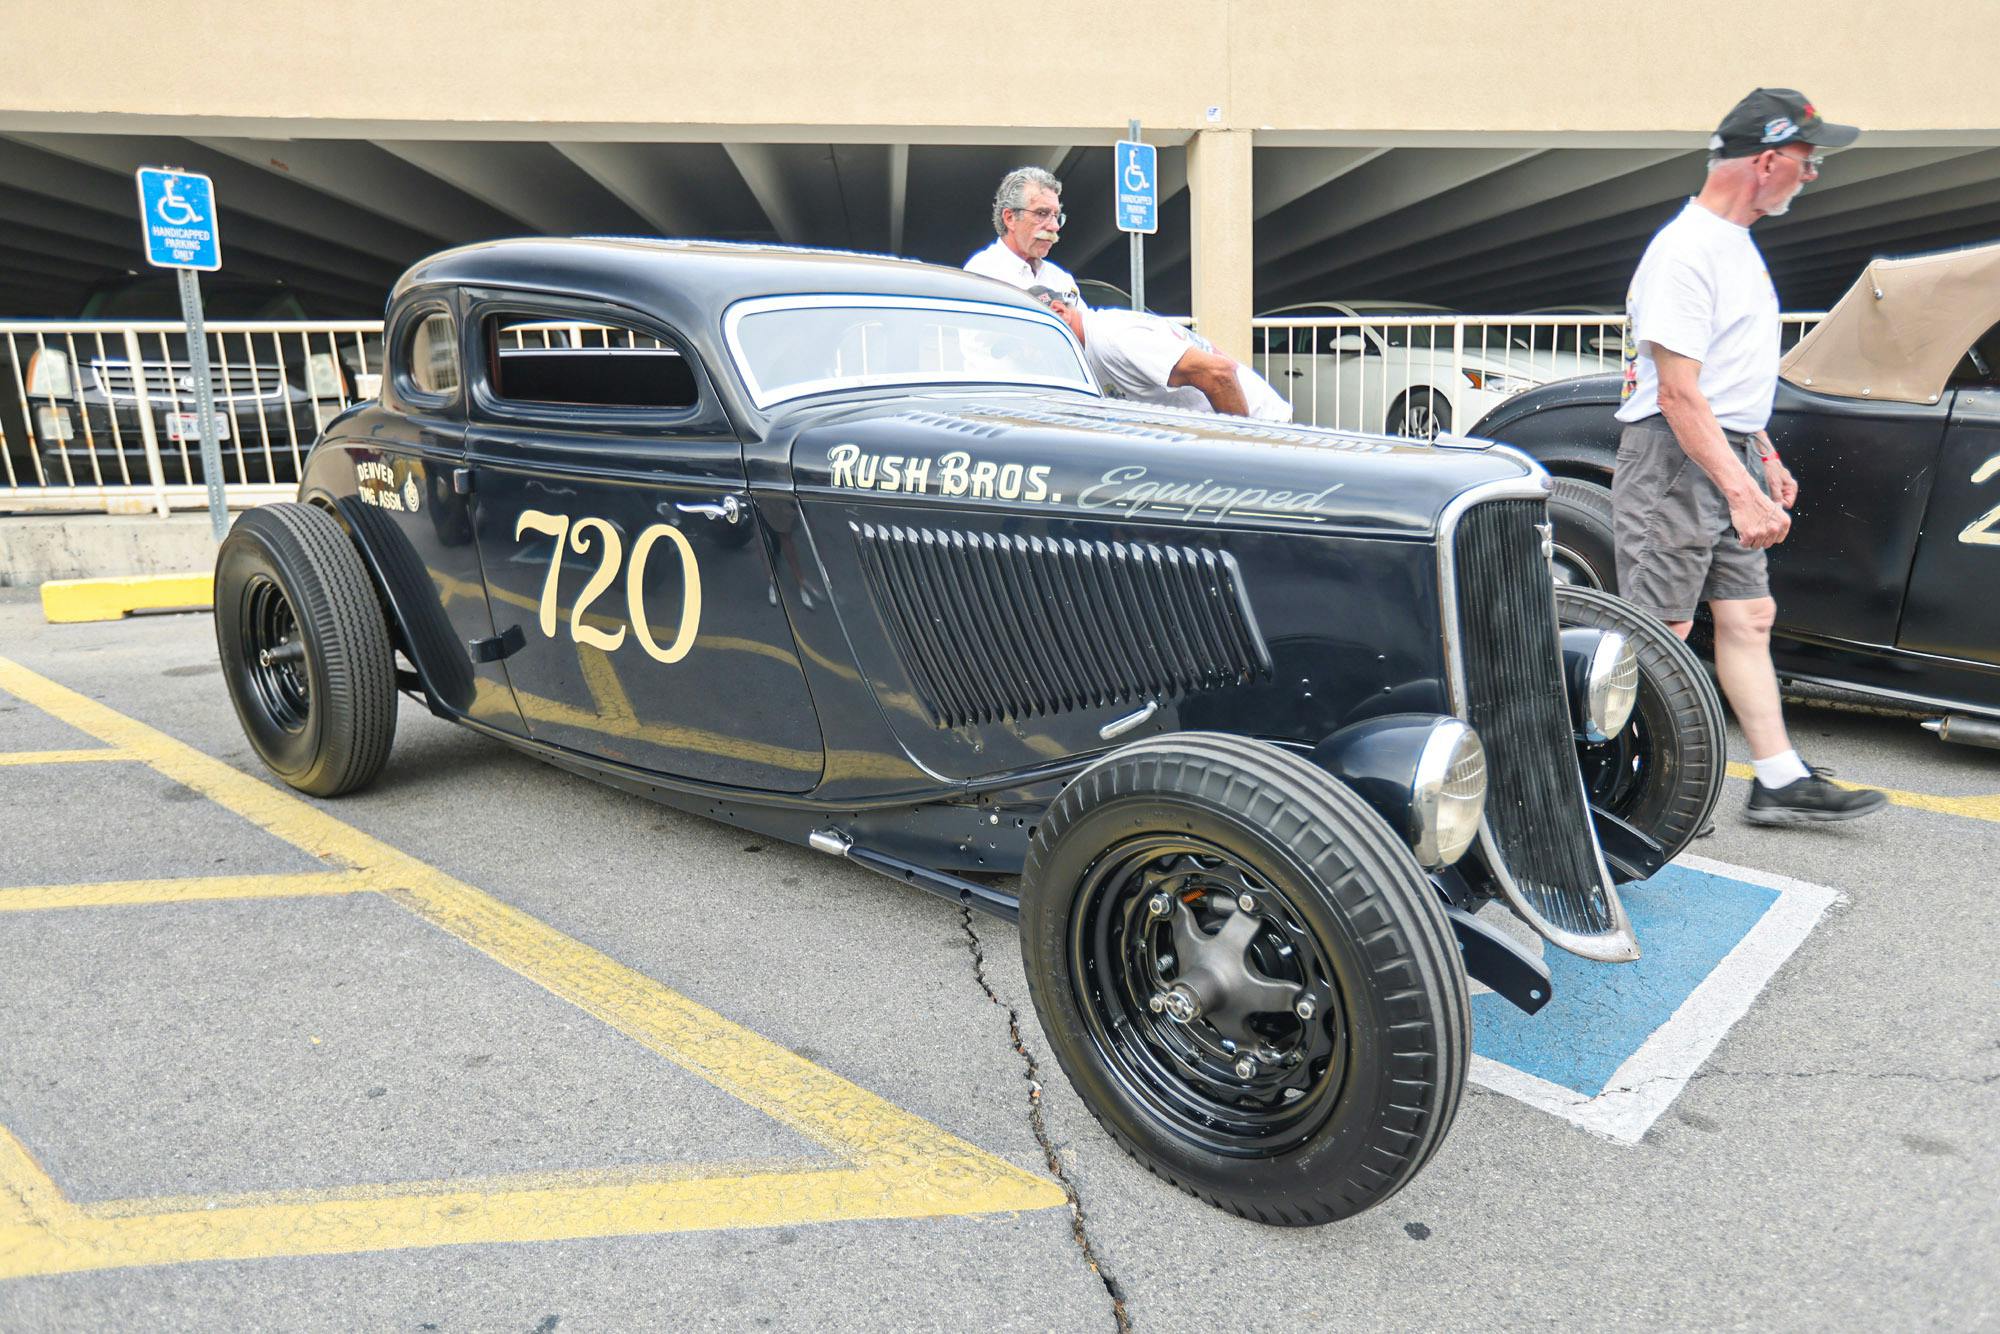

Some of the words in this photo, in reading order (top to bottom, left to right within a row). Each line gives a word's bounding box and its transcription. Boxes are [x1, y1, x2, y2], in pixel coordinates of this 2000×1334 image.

[152, 225, 211, 241] HANDICAPPED
[165, 238, 201, 251] PARKING
[173, 249, 195, 261] ONLY
[356, 462, 395, 488] DENVER
[828, 444, 932, 494] RUSH
[937, 451, 1062, 504] BROS.
[1077, 465, 1344, 524] Equipped
[379, 490, 405, 512] ASSN.
[515, 509, 702, 664] 720
